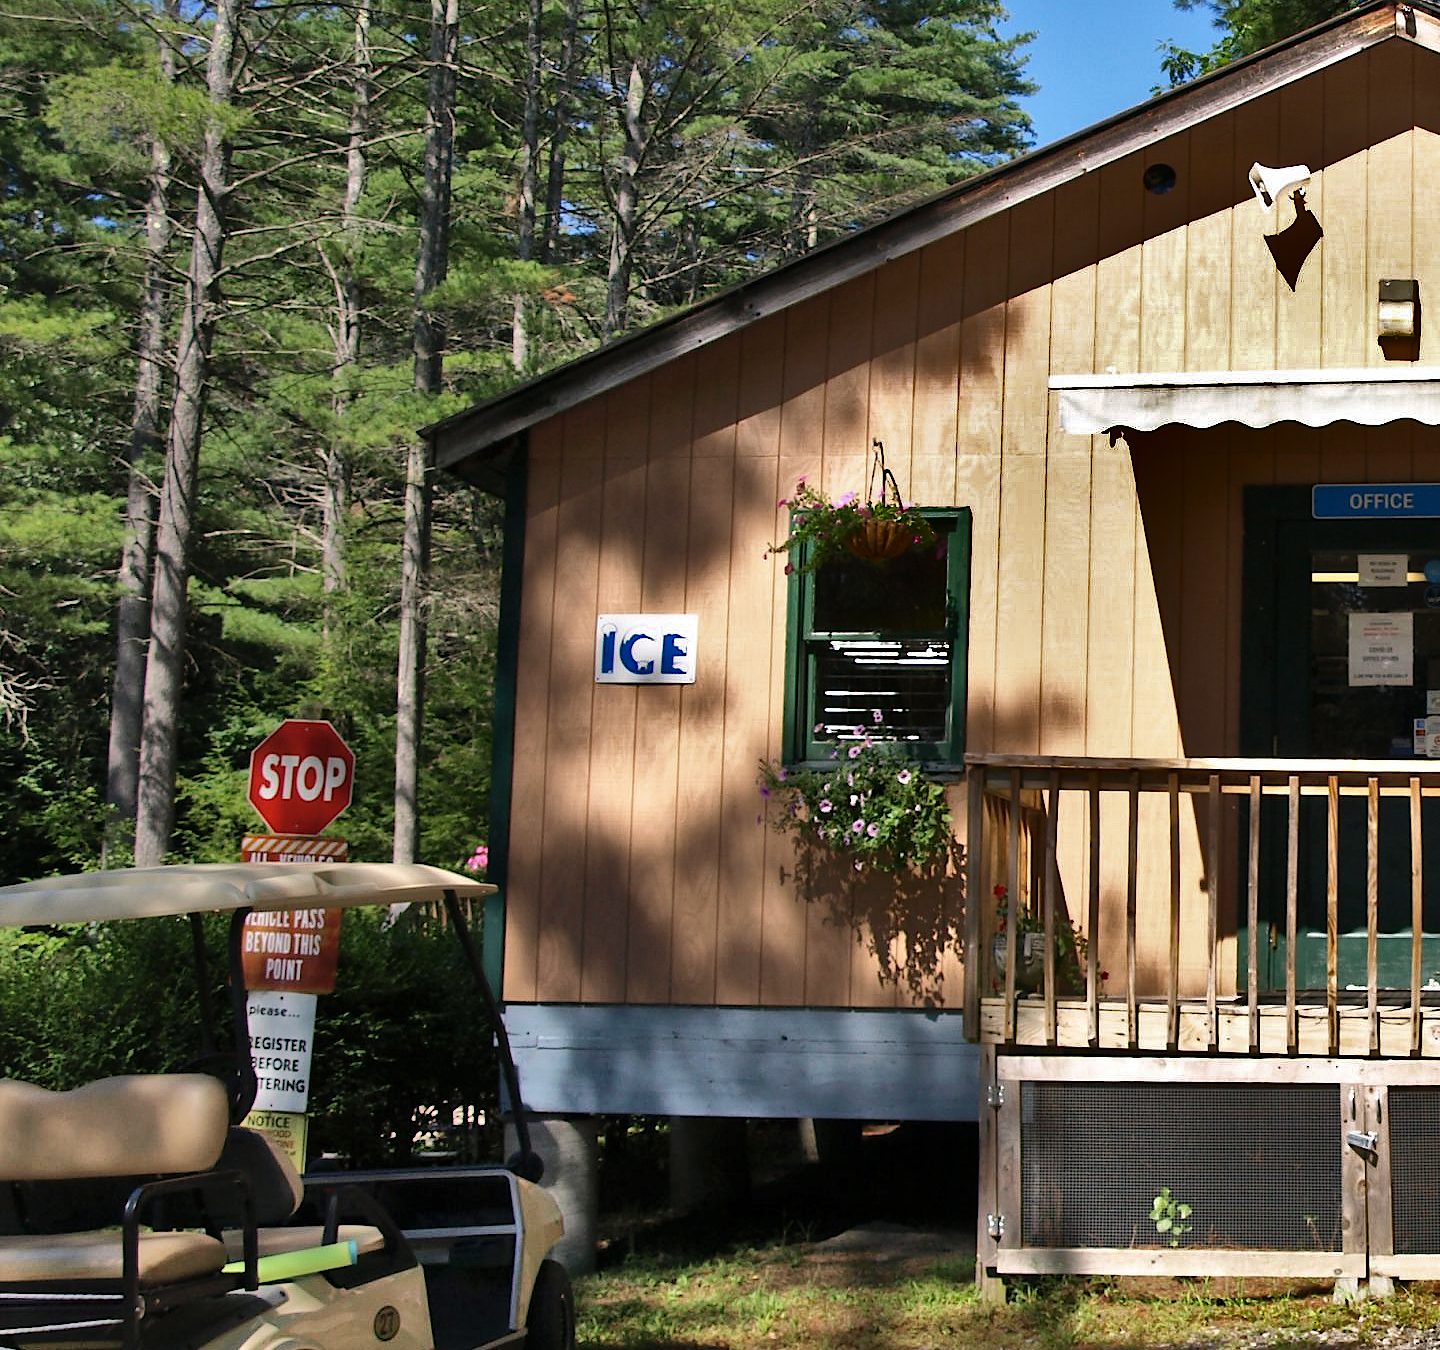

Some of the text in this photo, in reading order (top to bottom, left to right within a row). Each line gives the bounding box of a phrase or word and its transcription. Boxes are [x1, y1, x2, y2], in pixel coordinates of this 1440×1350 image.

[1350, 493, 1415, 510] OFFICE
[601, 626, 687, 674] ICE
[259, 754, 346, 801] STOP
[294, 908, 326, 929] PASS
[246, 931, 321, 956] BEYOND THIS
[265, 958, 303, 981] POINT
[251, 1056, 299, 1072] BEFORE
[257, 1078, 305, 1093] TERING
[247, 1115, 291, 1129] NOTICE
